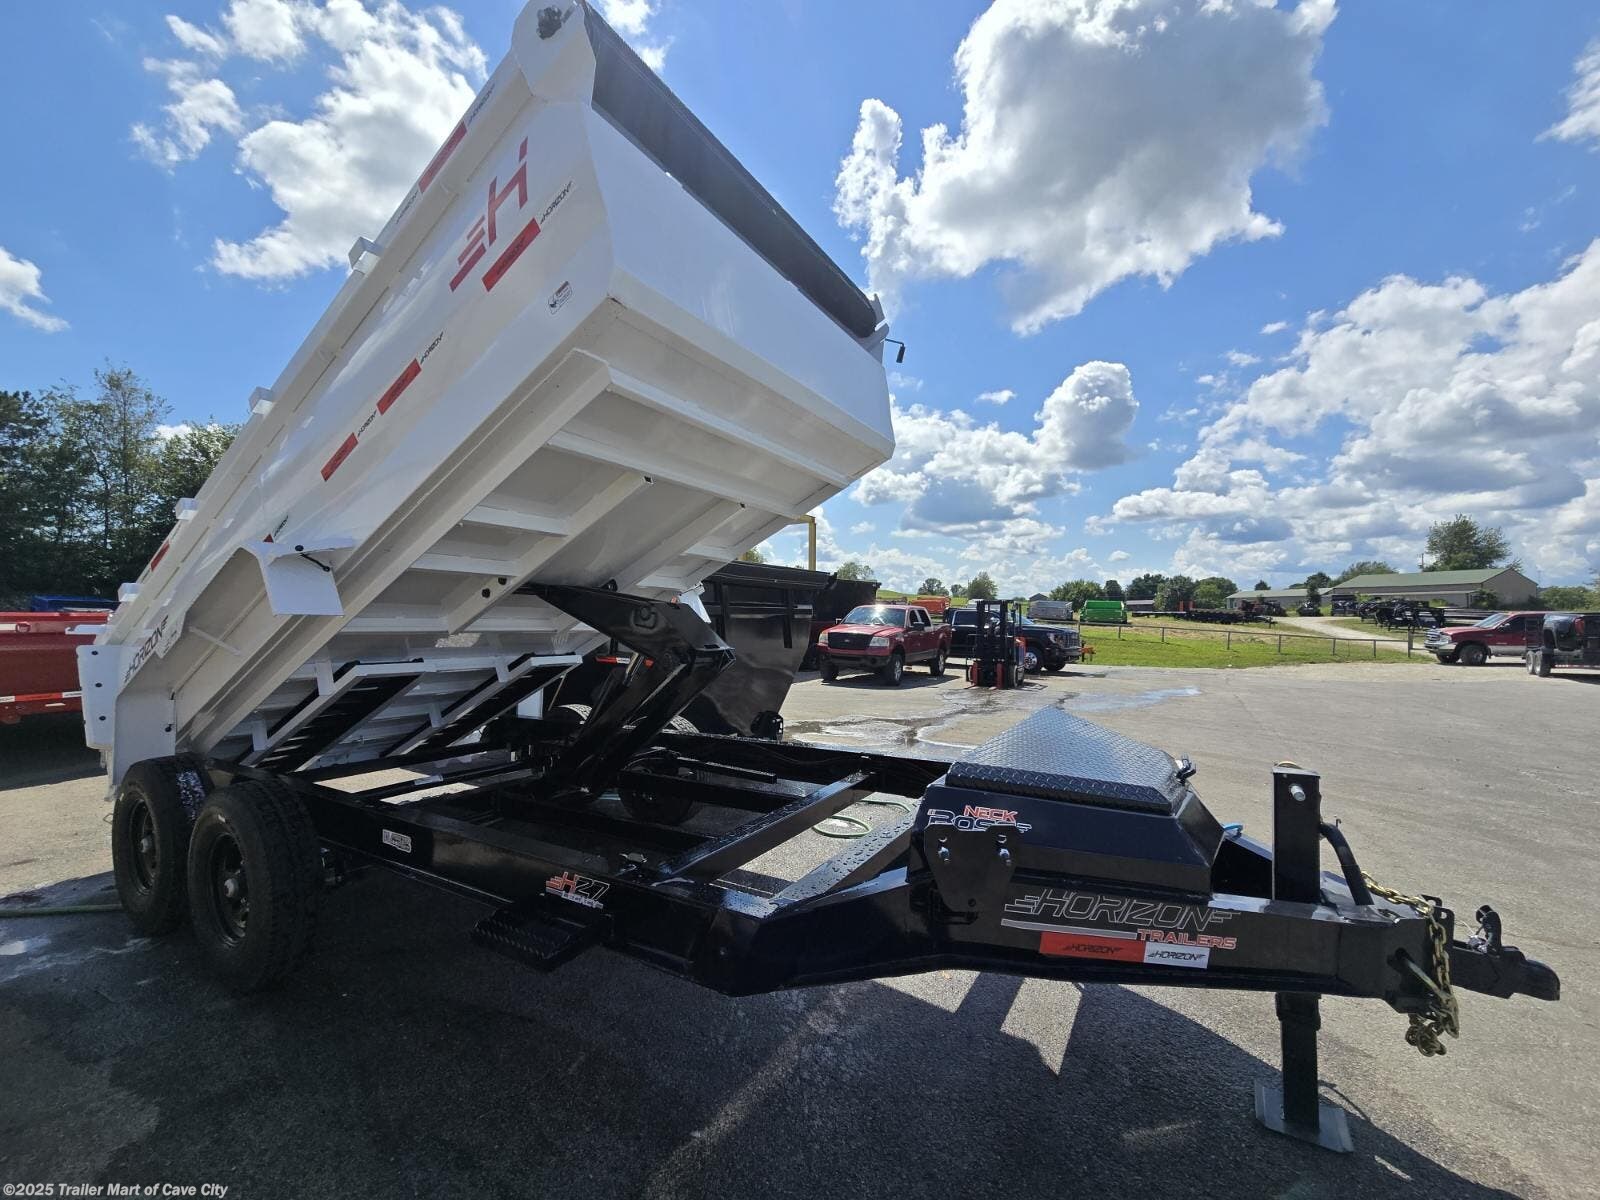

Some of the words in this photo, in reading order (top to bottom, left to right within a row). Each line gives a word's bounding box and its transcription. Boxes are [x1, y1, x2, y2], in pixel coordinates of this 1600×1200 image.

[963, 805, 1018, 822] NECK
[1004, 888, 1238, 931] HORIZON
[1137, 928, 1238, 950] TRAILERS
[1148, 950, 1205, 962] HORIZON
